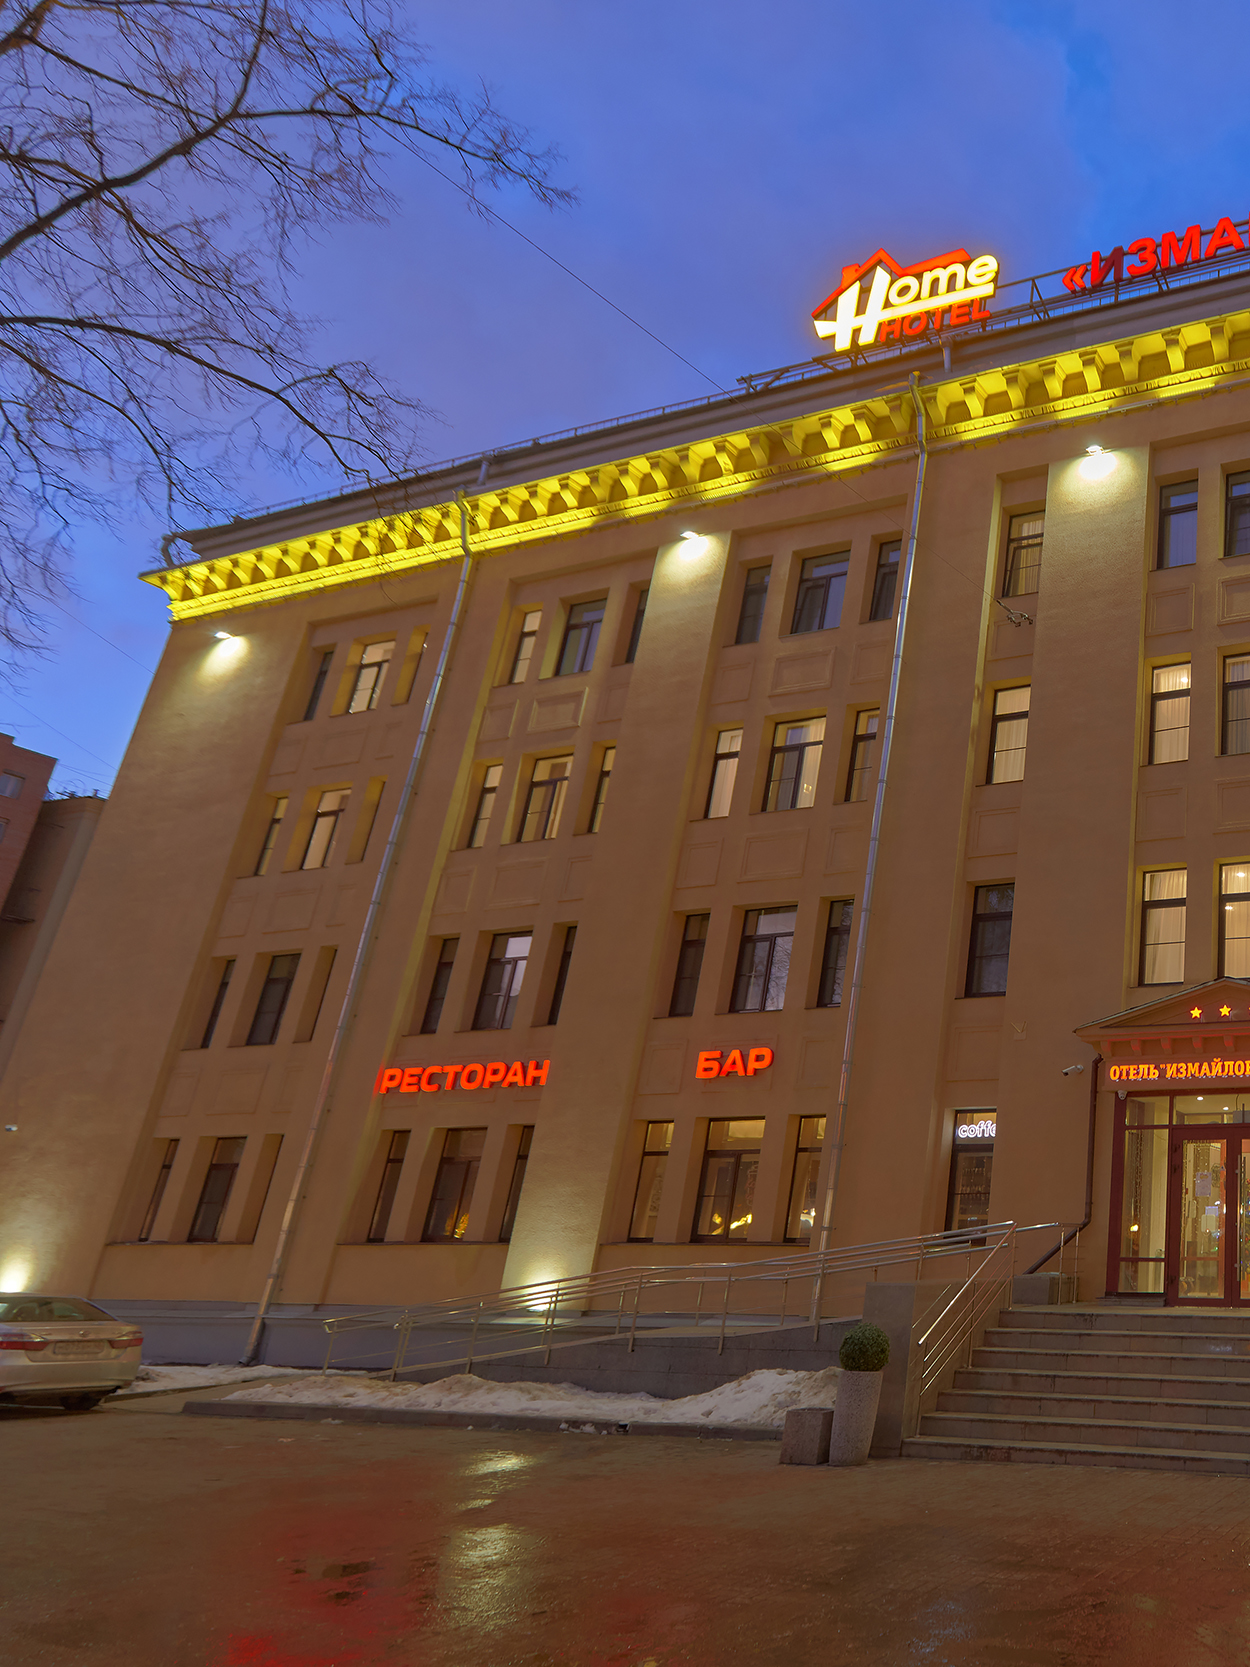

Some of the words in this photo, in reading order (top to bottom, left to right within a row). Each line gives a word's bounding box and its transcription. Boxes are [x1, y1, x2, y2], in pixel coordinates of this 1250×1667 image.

[813, 254, 998, 352] Home
[879, 298, 991, 342] HOTEL
[379, 1059, 551, 1094] РЕСТОРАН
[695, 1046, 774, 1079] БАР
[1109, 1064, 1160, 1081] ОТЕЛЬ
